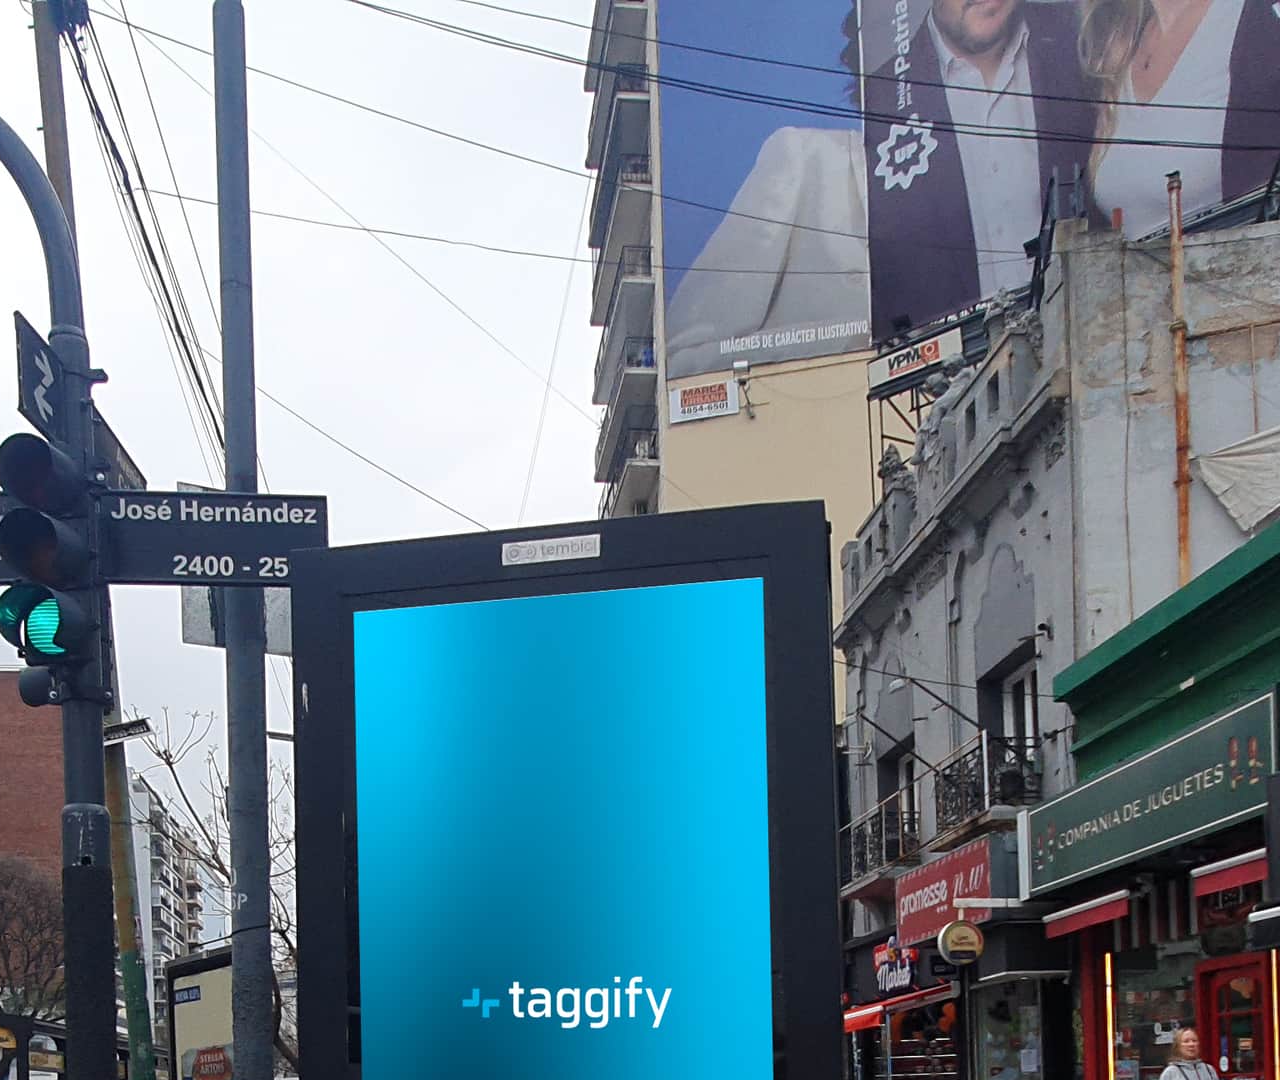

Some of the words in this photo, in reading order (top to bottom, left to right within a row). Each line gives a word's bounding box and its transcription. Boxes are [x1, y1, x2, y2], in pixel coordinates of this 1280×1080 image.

[720, 336, 761, 353] IMÁGENES
[762, 335, 774, 348] DE
[775, 327, 816, 346] CARÁCTER
[818, 320, 868, 340] ILUSTRATIVO
[888, 347, 922, 371] VPM
[681, 383, 726, 397] MARCA
[111, 498, 171, 521] José
[180, 500, 317, 524] Hernández
[173, 555, 234, 577] 2400
[259, 557, 289, 577] 25
[1122, 799, 1142, 823] DE
[1144, 763, 1225, 814] JUGUETES
[899, 879, 948, 925] promesse
[876, 958, 912, 992] Market
[508, 976, 673, 1029] taggify
[199, 1053, 224, 1063] STELLA
[199, 1063, 225, 1075] ARTOIS
